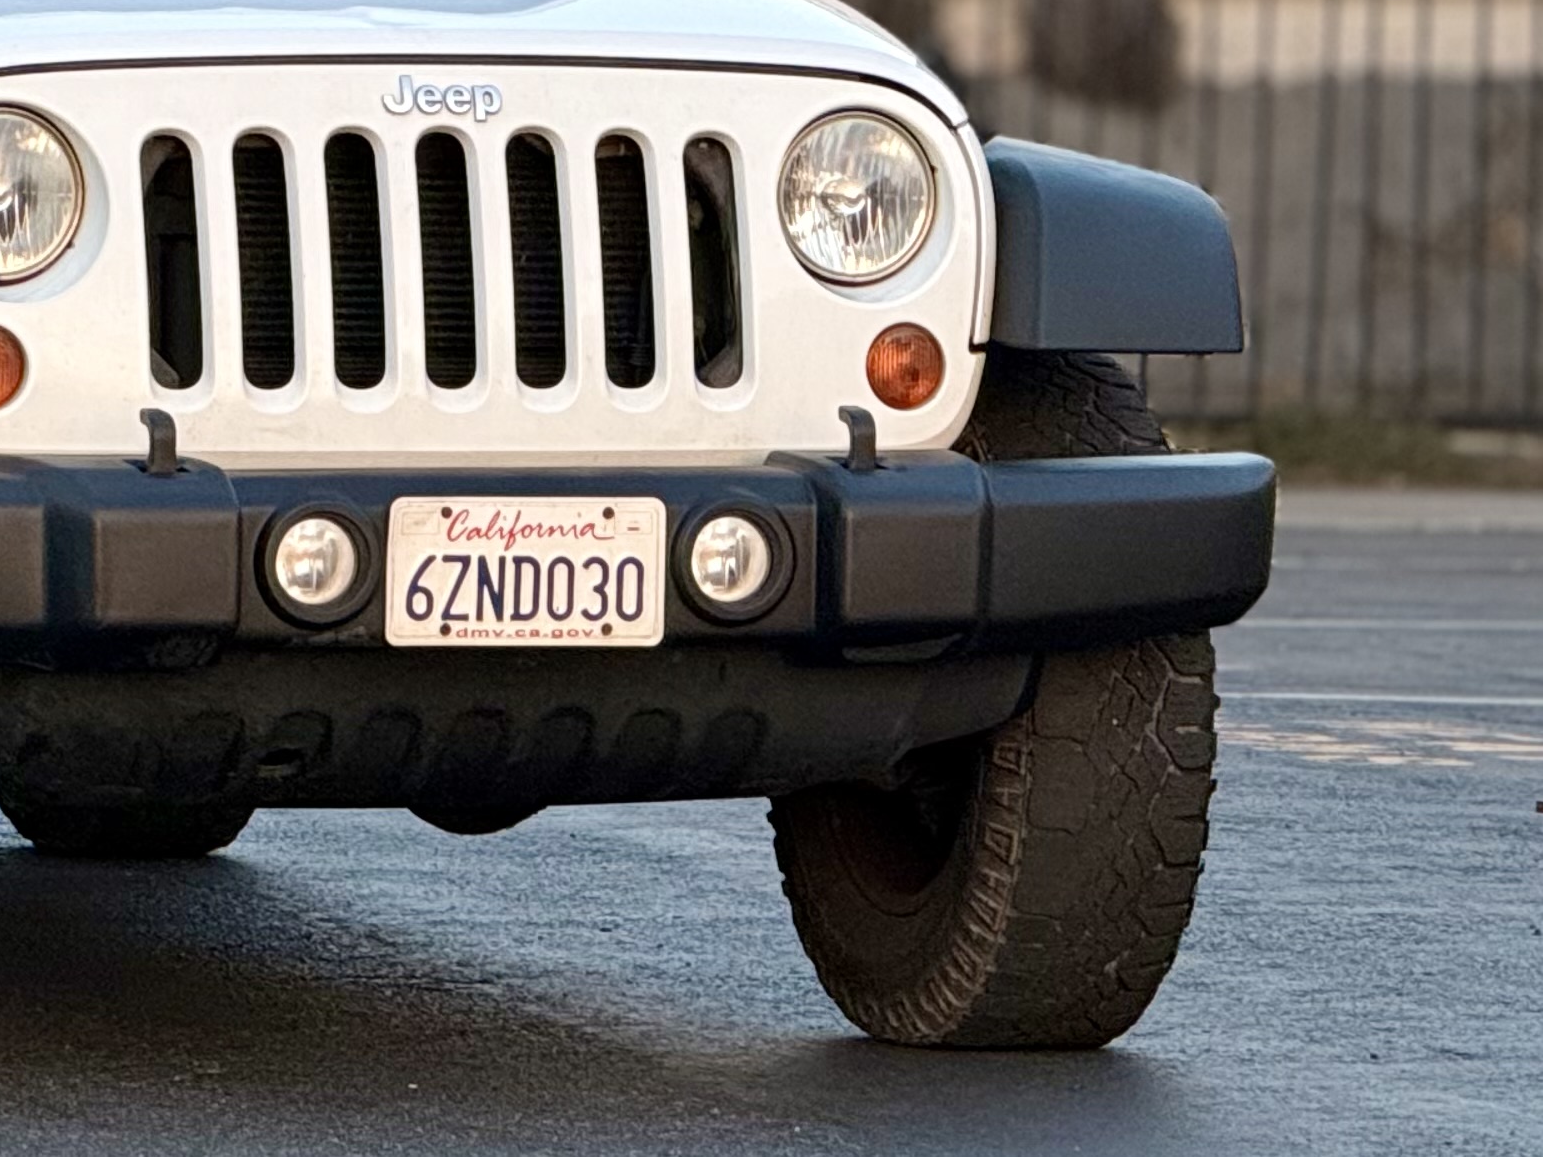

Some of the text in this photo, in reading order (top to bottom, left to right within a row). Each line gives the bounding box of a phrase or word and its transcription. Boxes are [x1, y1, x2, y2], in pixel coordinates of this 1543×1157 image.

[382, 74, 502, 123] Jeep
[446, 509, 615, 551] California
[405, 554, 645, 623] 6ZND030
[456, 626, 594, 639] dmv.ca.gov
